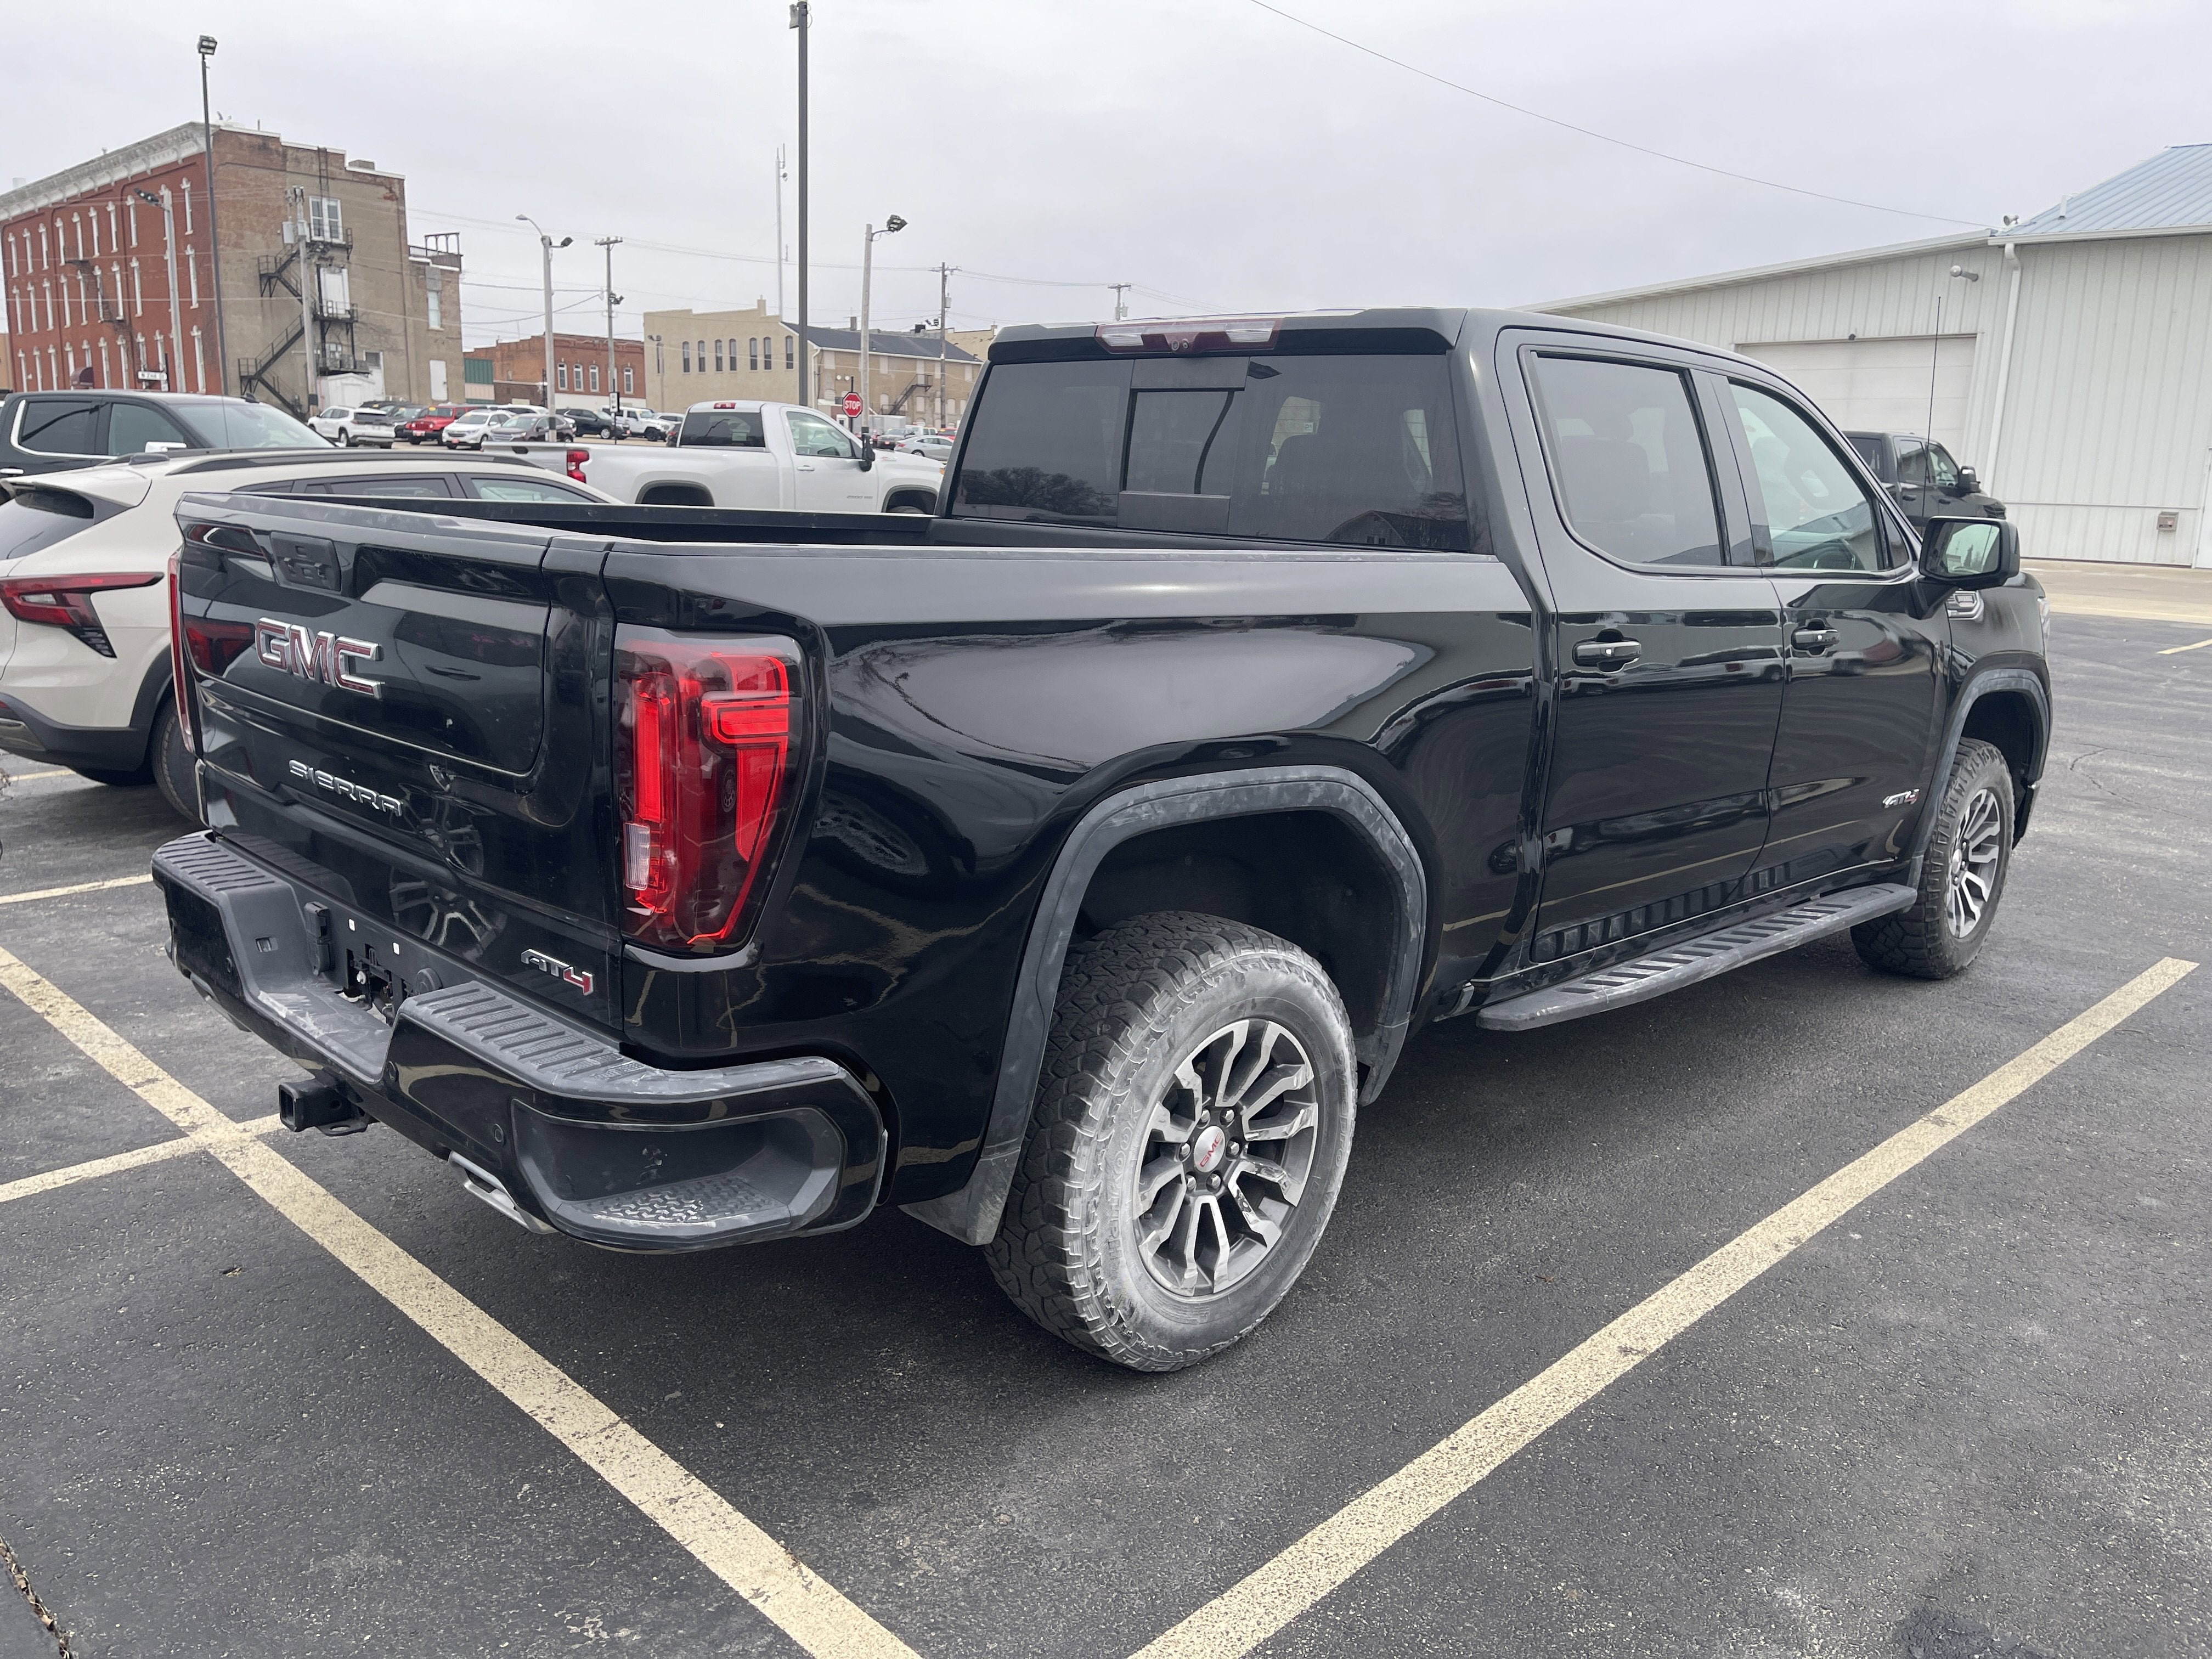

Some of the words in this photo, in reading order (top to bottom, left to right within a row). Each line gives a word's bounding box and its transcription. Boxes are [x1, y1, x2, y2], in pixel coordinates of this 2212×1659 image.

[845, 400, 861, 410] STOP
[255, 617, 383, 699] GMC
[289, 759, 403, 817] SIERRA
[1882, 788, 1919, 809] AT4
[521, 949, 594, 996] AT4
[1200, 1132, 1222, 1167] GMC
